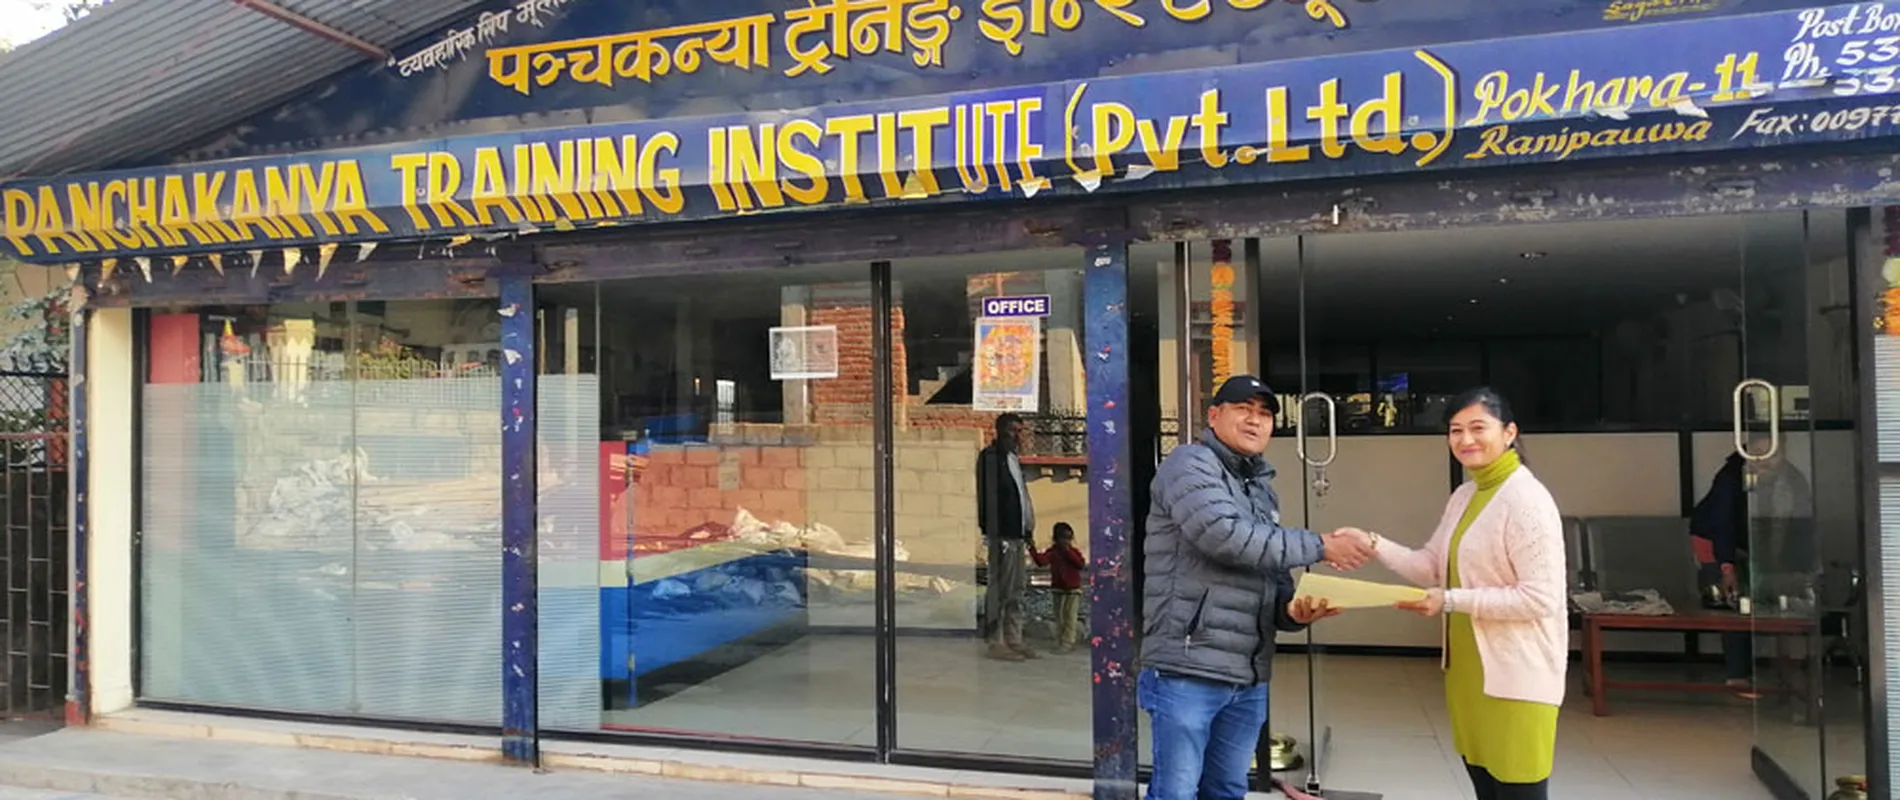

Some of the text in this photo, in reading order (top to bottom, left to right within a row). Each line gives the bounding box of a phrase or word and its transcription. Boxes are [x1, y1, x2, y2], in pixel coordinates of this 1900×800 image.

[1464, 118, 1713, 161] Ranipauwa
[3, 160, 388, 255] PANCHAKANYA
[390, 131, 685, 230] TRAINING
[707, 97, 1050, 211] INSTITUTE
[987, 299, 1045, 314] OFFICE
